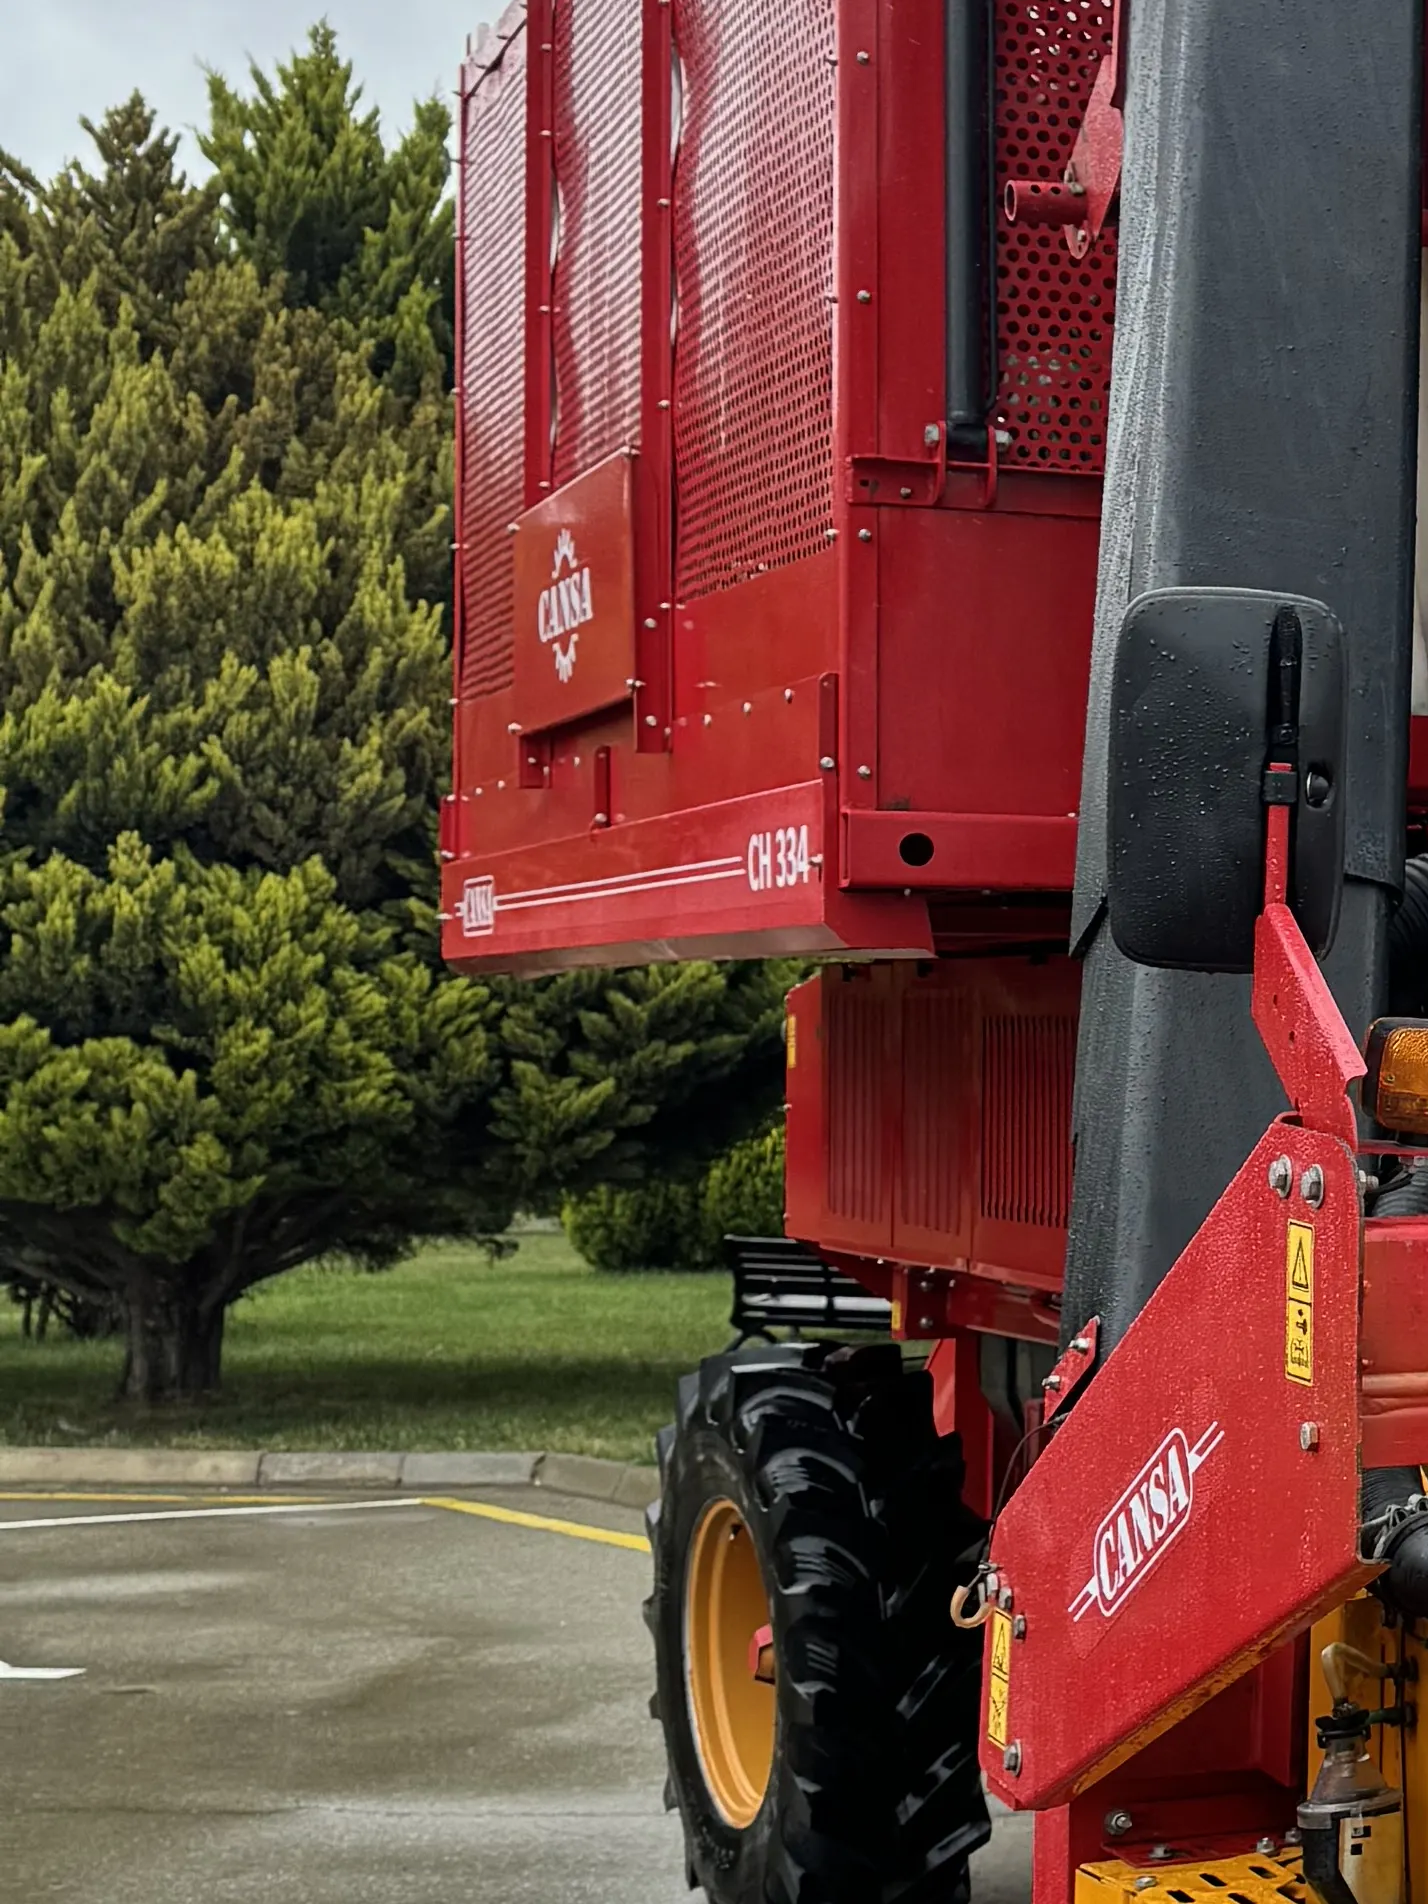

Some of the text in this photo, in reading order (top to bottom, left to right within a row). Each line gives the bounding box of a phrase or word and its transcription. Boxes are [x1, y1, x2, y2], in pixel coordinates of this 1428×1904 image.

[538, 567, 593, 643] CANSA
[748, 824, 811, 892] CH 334
[1100, 1445, 1189, 1600] CANSA
